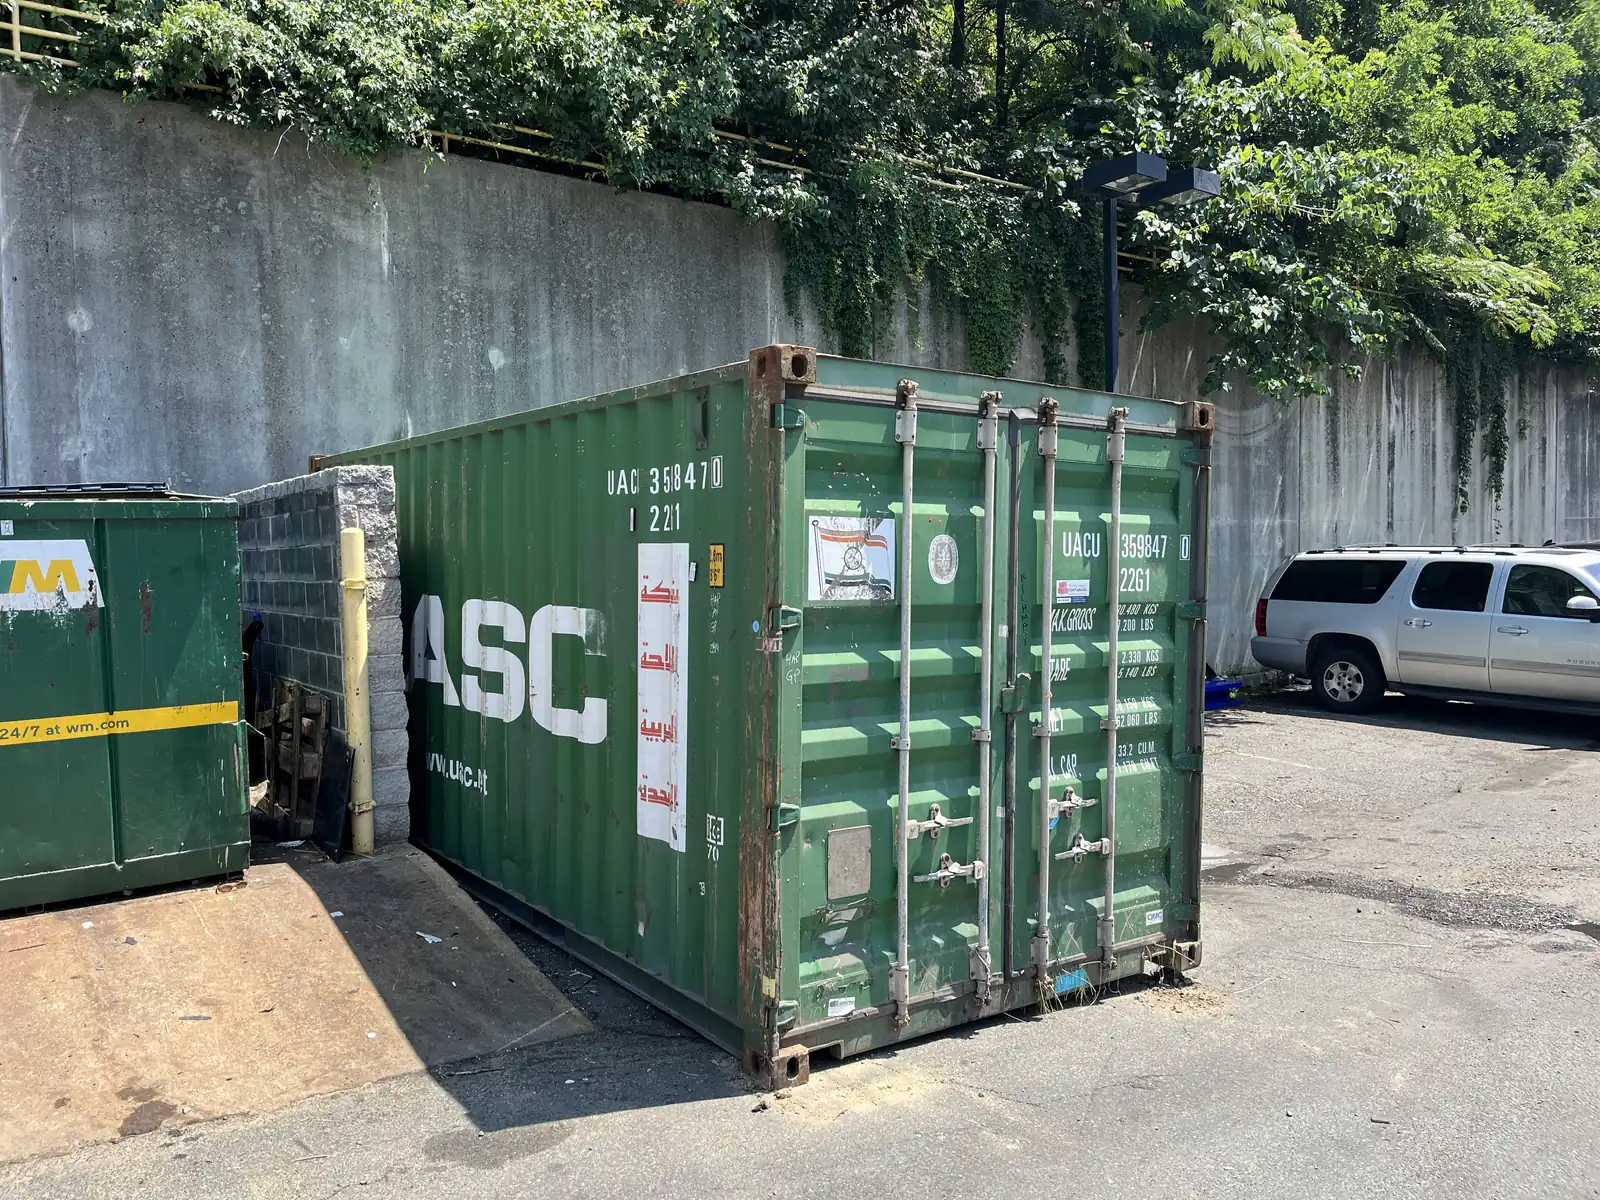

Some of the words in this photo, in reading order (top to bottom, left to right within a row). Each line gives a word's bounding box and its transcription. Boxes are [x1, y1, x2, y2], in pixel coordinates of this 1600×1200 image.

[1063, 532, 1100, 558] UACU
[1121, 534, 1168, 558] 359847
[1181, 536, 1190, 559] 0
[0, 559, 81, 594] M
[1120, 568, 1150, 592] 22G1
[1142, 603, 1160, 615] KGS
[1140, 618, 1154, 631] LBS
[1121, 651, 1141, 664] 2.330
[1145, 650, 1160, 662] KGS
[1118, 667, 1140, 679] 5.140
[1141, 666, 1158, 677] LBS
[1144, 712, 1158, 725] LBS
[0, 725, 40, 740] 24/7
[46, 724, 60, 736] at
[66, 718, 130, 734] wm.com
[1117, 743, 1134, 757] 33.2
